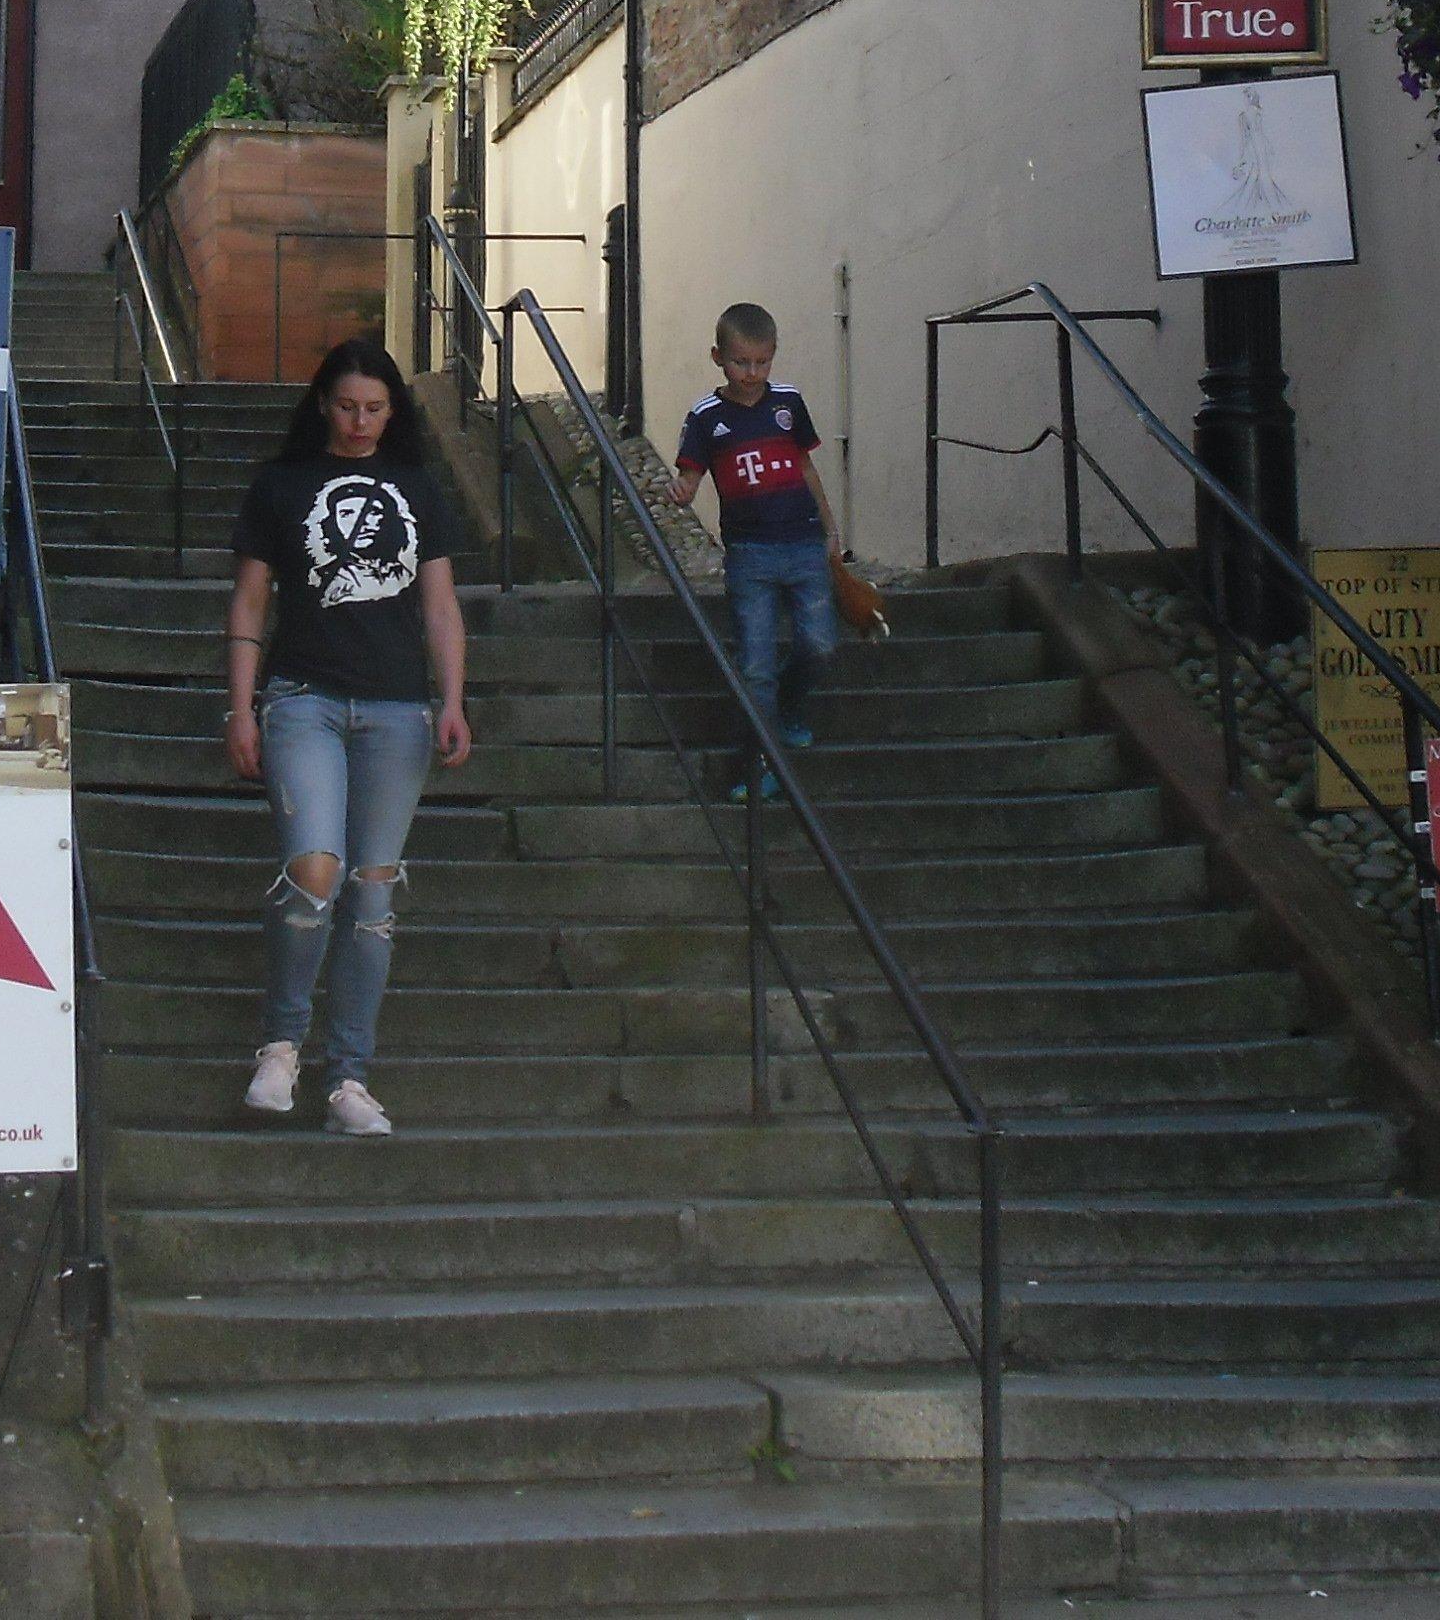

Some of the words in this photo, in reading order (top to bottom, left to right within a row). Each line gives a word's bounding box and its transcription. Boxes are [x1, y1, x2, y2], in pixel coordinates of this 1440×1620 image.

[1173, 0, 1295, 40] True.
[1323, 580, 1368, 596] TOP
[1374, 580, 1401, 594] OF
[1368, 608, 1428, 639] CITY
